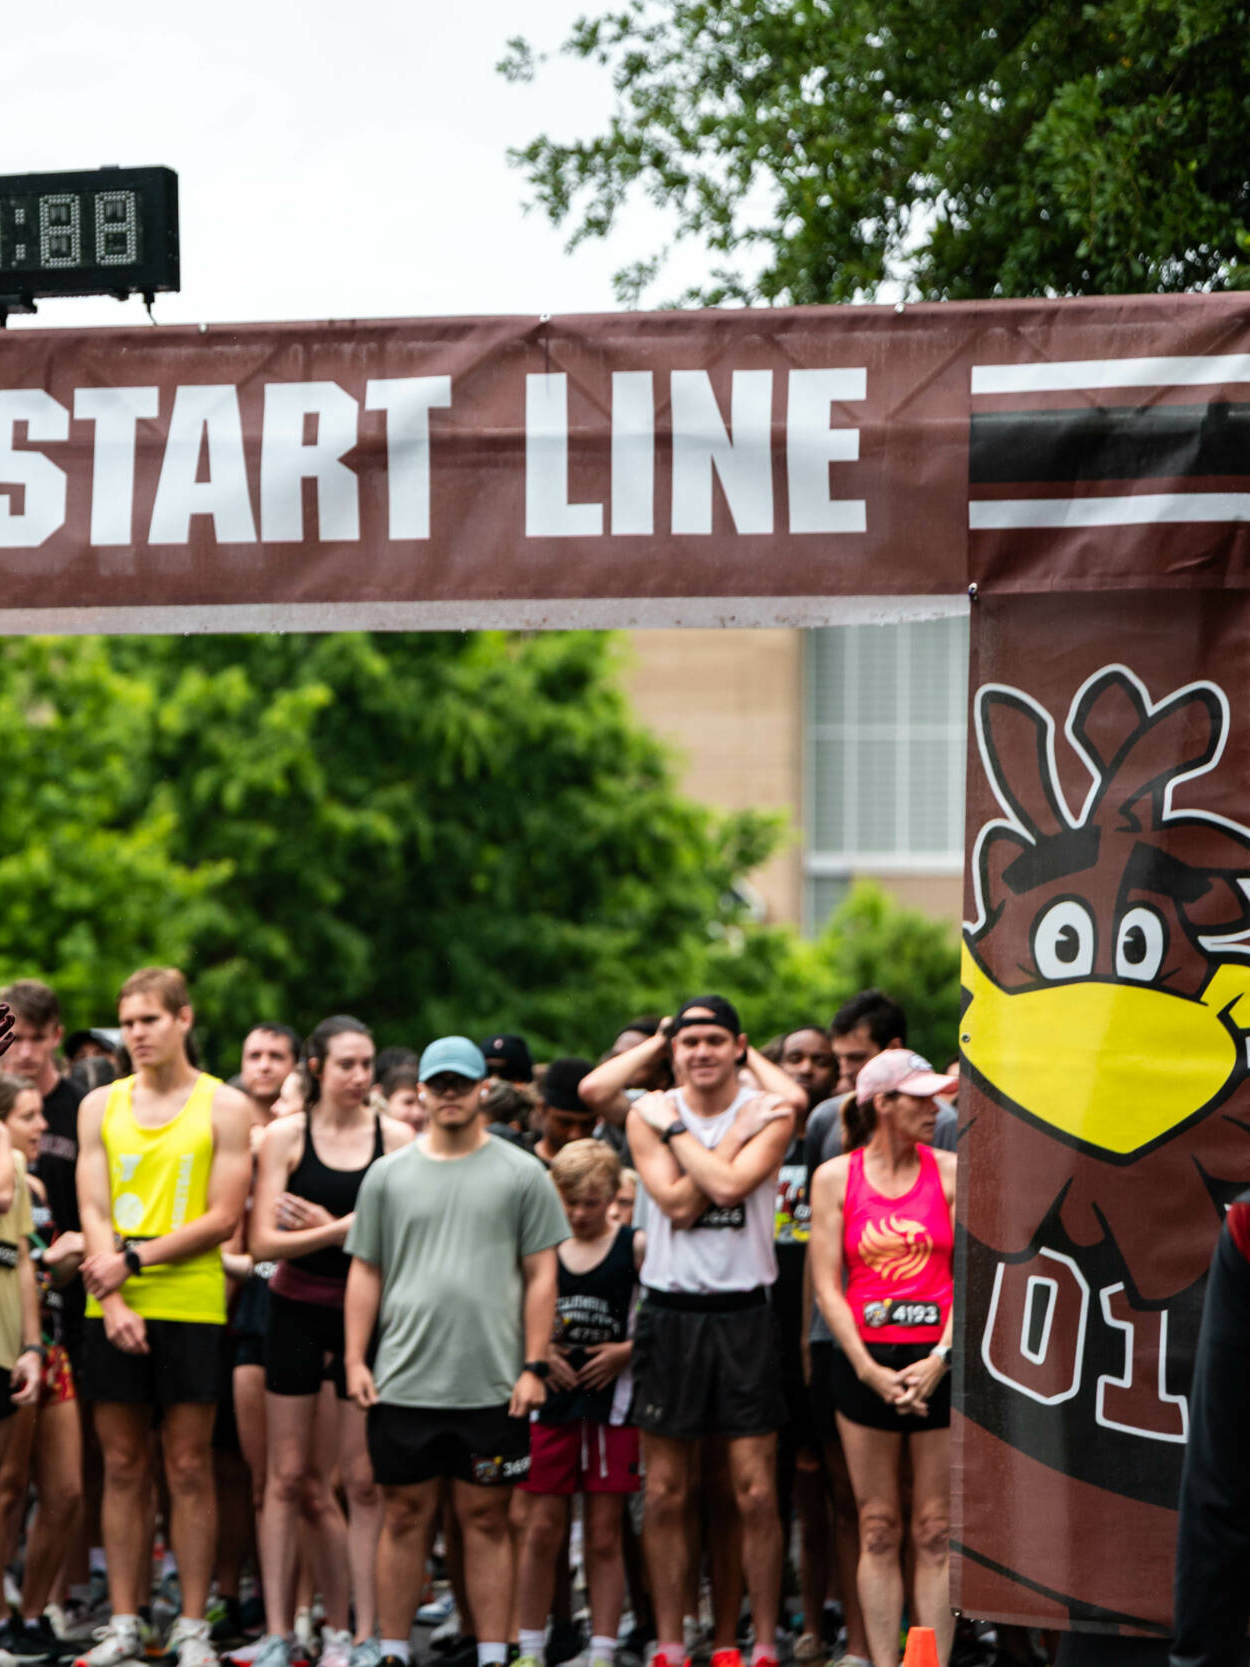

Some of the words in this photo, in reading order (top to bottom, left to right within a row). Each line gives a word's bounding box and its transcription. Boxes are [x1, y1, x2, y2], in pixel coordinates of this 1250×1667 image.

[525, 367, 868, 538] LINE
[892, 1304, 938, 1323] 4193
[981, 1246, 1189, 1444] 01
